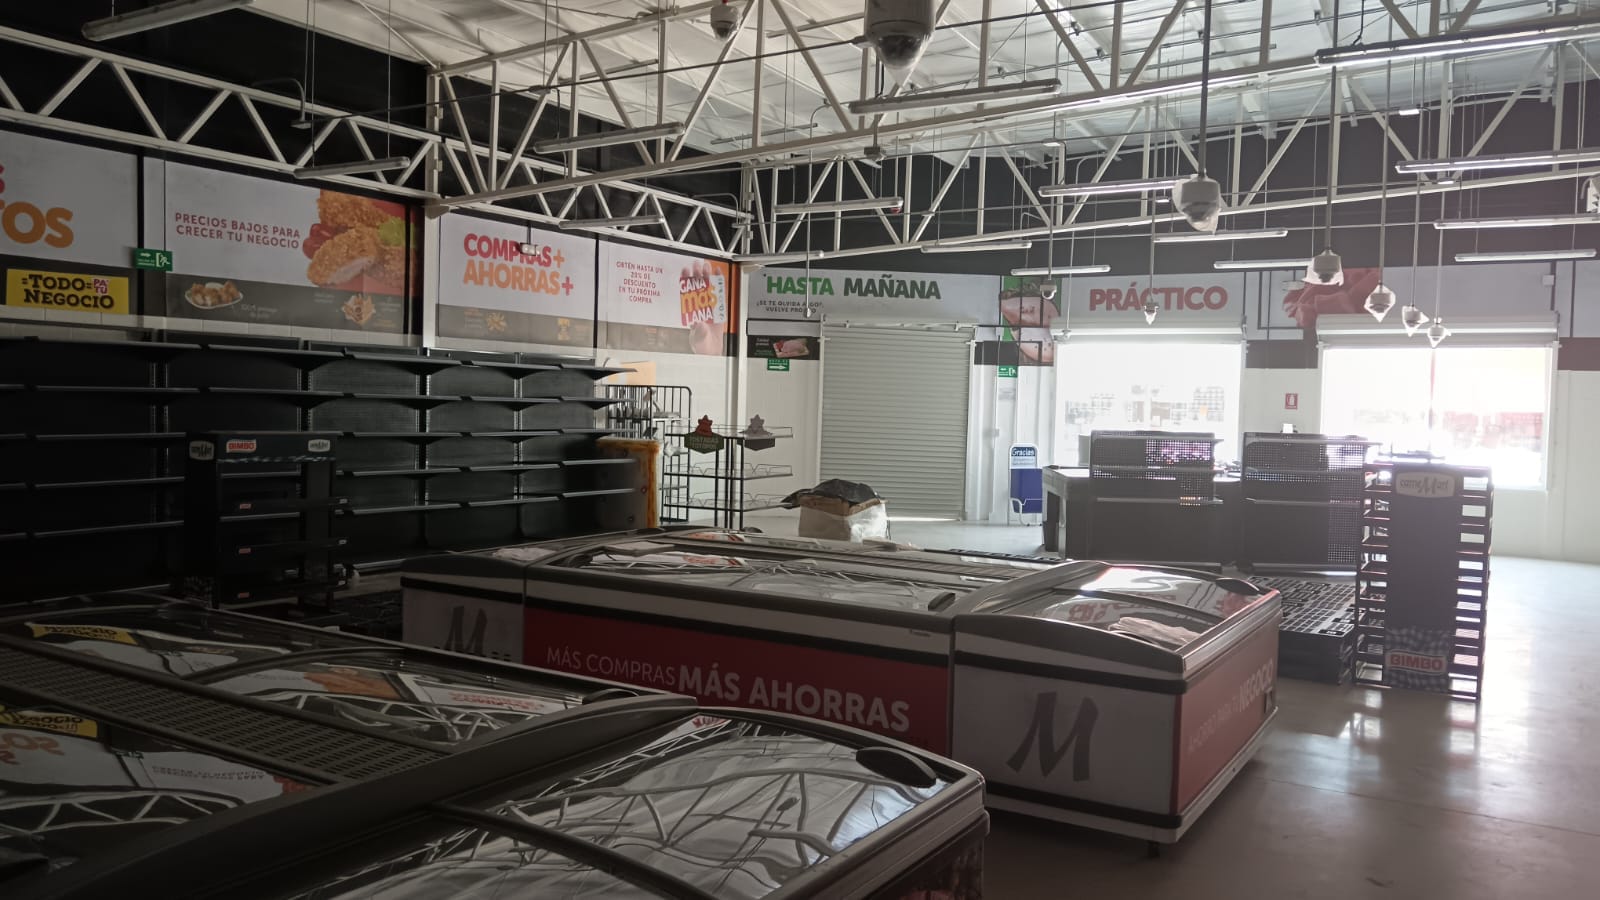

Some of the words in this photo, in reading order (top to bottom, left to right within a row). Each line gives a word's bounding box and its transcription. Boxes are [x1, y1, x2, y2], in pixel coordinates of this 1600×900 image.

[175, 212, 227, 229] PRECIOS
[231, 220, 269, 234] BAJOS
[272, 226, 300, 238] PARA
[176, 225, 223, 239] CRECER
[227, 231, 243, 242] TU
[247, 234, 299, 249] NEGOCIO
[28, 274, 86, 291] TODO
[623, 278, 656, 289] DESCUENTO
[680, 276, 707, 293] GANA
[766, 275, 834, 296] HASTA
[844, 273, 941, 300] MAÑANA
[24, 288, 115, 309] NEGOCIO
[1089, 282, 1228, 311] PRÁCTICO
[1012, 448, 1035, 456] Gracias
[1390, 654, 1443, 671] BIMBO
[547, 645, 582, 669] MÁS
[586, 654, 675, 686] COMPRAS
[678, 662, 741, 701] MÁS
[748, 677, 910, 732] AHORRAS
